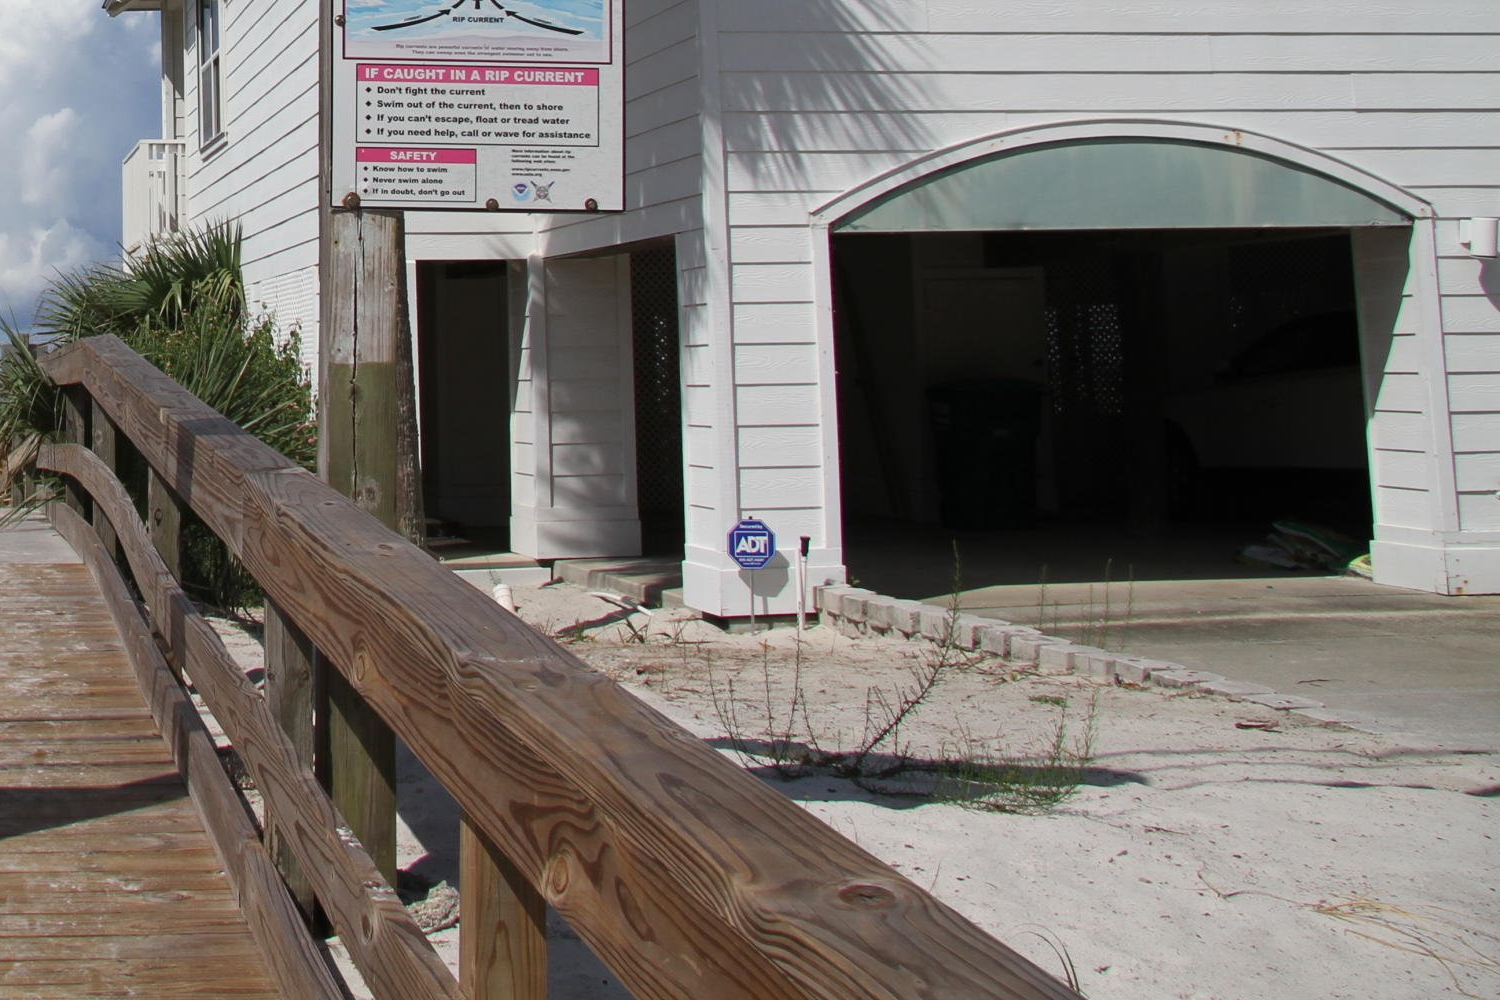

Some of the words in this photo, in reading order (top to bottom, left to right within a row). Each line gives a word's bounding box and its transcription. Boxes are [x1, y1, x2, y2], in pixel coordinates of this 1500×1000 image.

[365, 67, 379, 78] IF
[383, 68, 446, 79] CAUGHT
[450, 69, 466, 80] IN
[470, 70, 480, 80] A
[484, 70, 509, 81] RIP
[513, 70, 584, 82] CURRENT
[376, 86, 402, 94] Don't
[404, 86, 427, 96] fight
[456, 102, 496, 110] current,
[407, 114, 432, 122] can't
[434, 116, 473, 124] escape,
[512, 116, 539, 124] tread
[387, 129, 404, 137] you
[407, 128, 431, 136] need
[434, 129, 458, 137] help,
[389, 151, 436, 162] SAFETY
[736, 536, 768, 553] ADT
